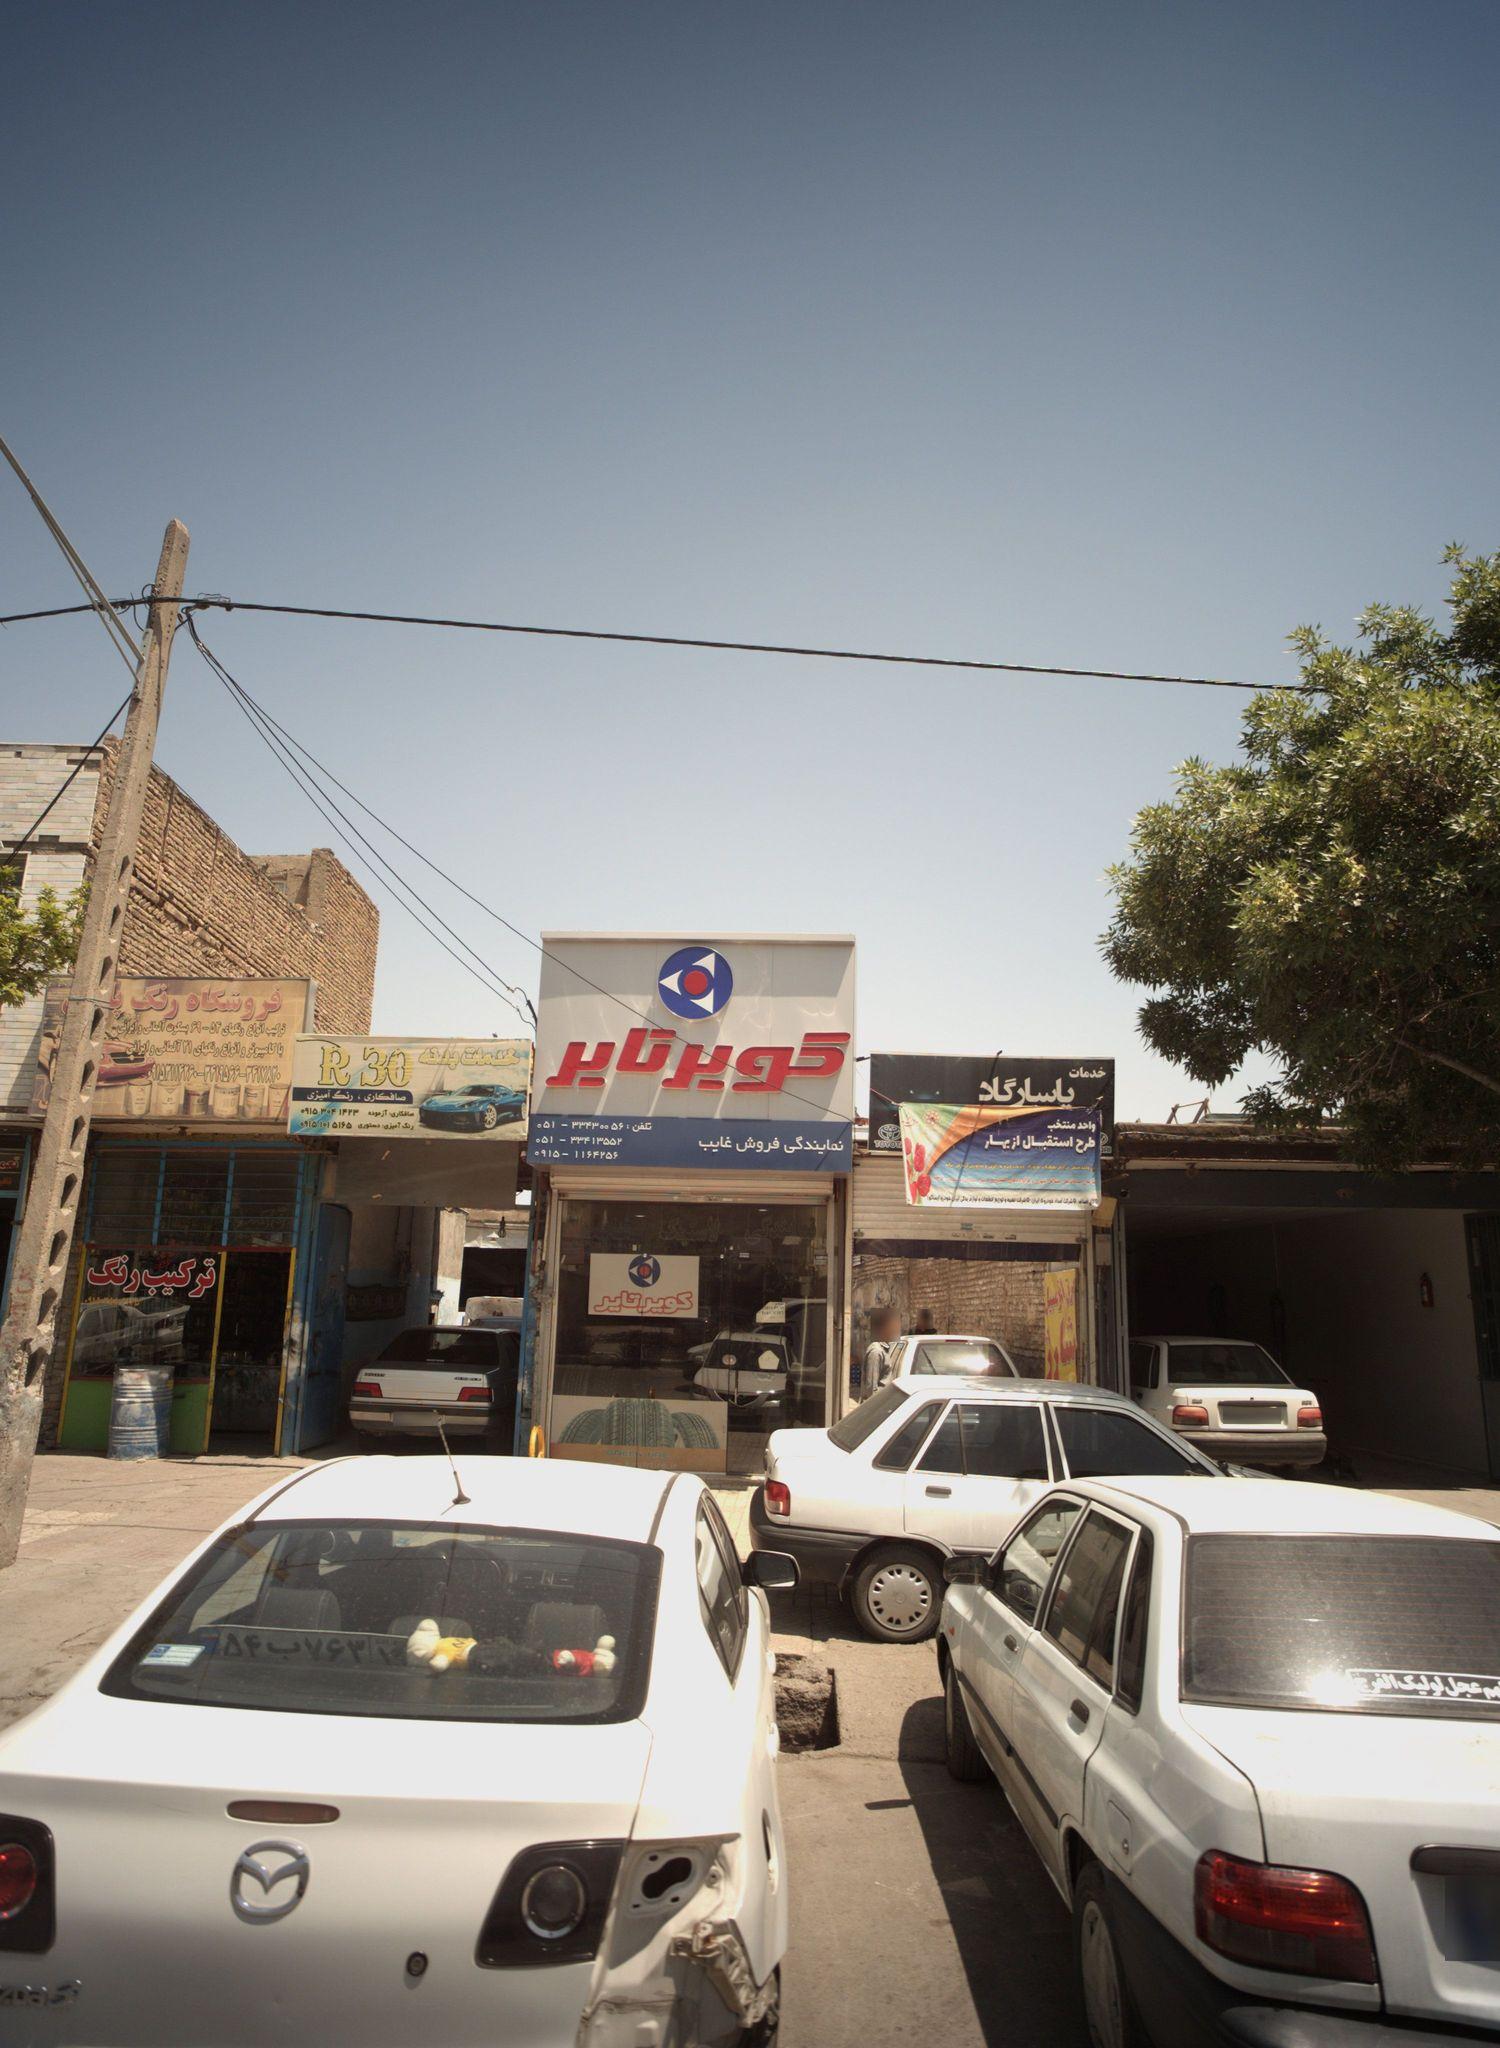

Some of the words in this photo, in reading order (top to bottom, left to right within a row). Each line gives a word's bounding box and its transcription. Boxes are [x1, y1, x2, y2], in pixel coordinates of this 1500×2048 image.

[131, 983, 179, 1019] رنگ
[186, 984, 283, 1021] فروشگاه
[460, 1046, 521, 1067] خدمات
[318, 1045, 351, 1086] R
[360, 1046, 413, 1088] 30
[1068, 1066, 1106, 1079] خدمات
[307, 1089, 331, 1101] آمیزی
[332, 1090, 354, 1101] رنگ
[364, 1091, 407, 1103] صافکاری
[1047, 1120, 1075, 1132] منتخب
[1077, 1121, 1096, 1132] واحد
[698, 1135, 733, 1152] غایب
[736, 1136, 780, 1153] فروش
[783, 1135, 845, 1155] نمایندگی
[1022, 1135, 1073, 1151] استقبال
[1075, 1136, 1096, 1154] طرح
[87, 1255, 141, 1294] رنگ
[142, 1257, 216, 1298] ترکیب
[1445, 1677, 1483, 1698] عجل
